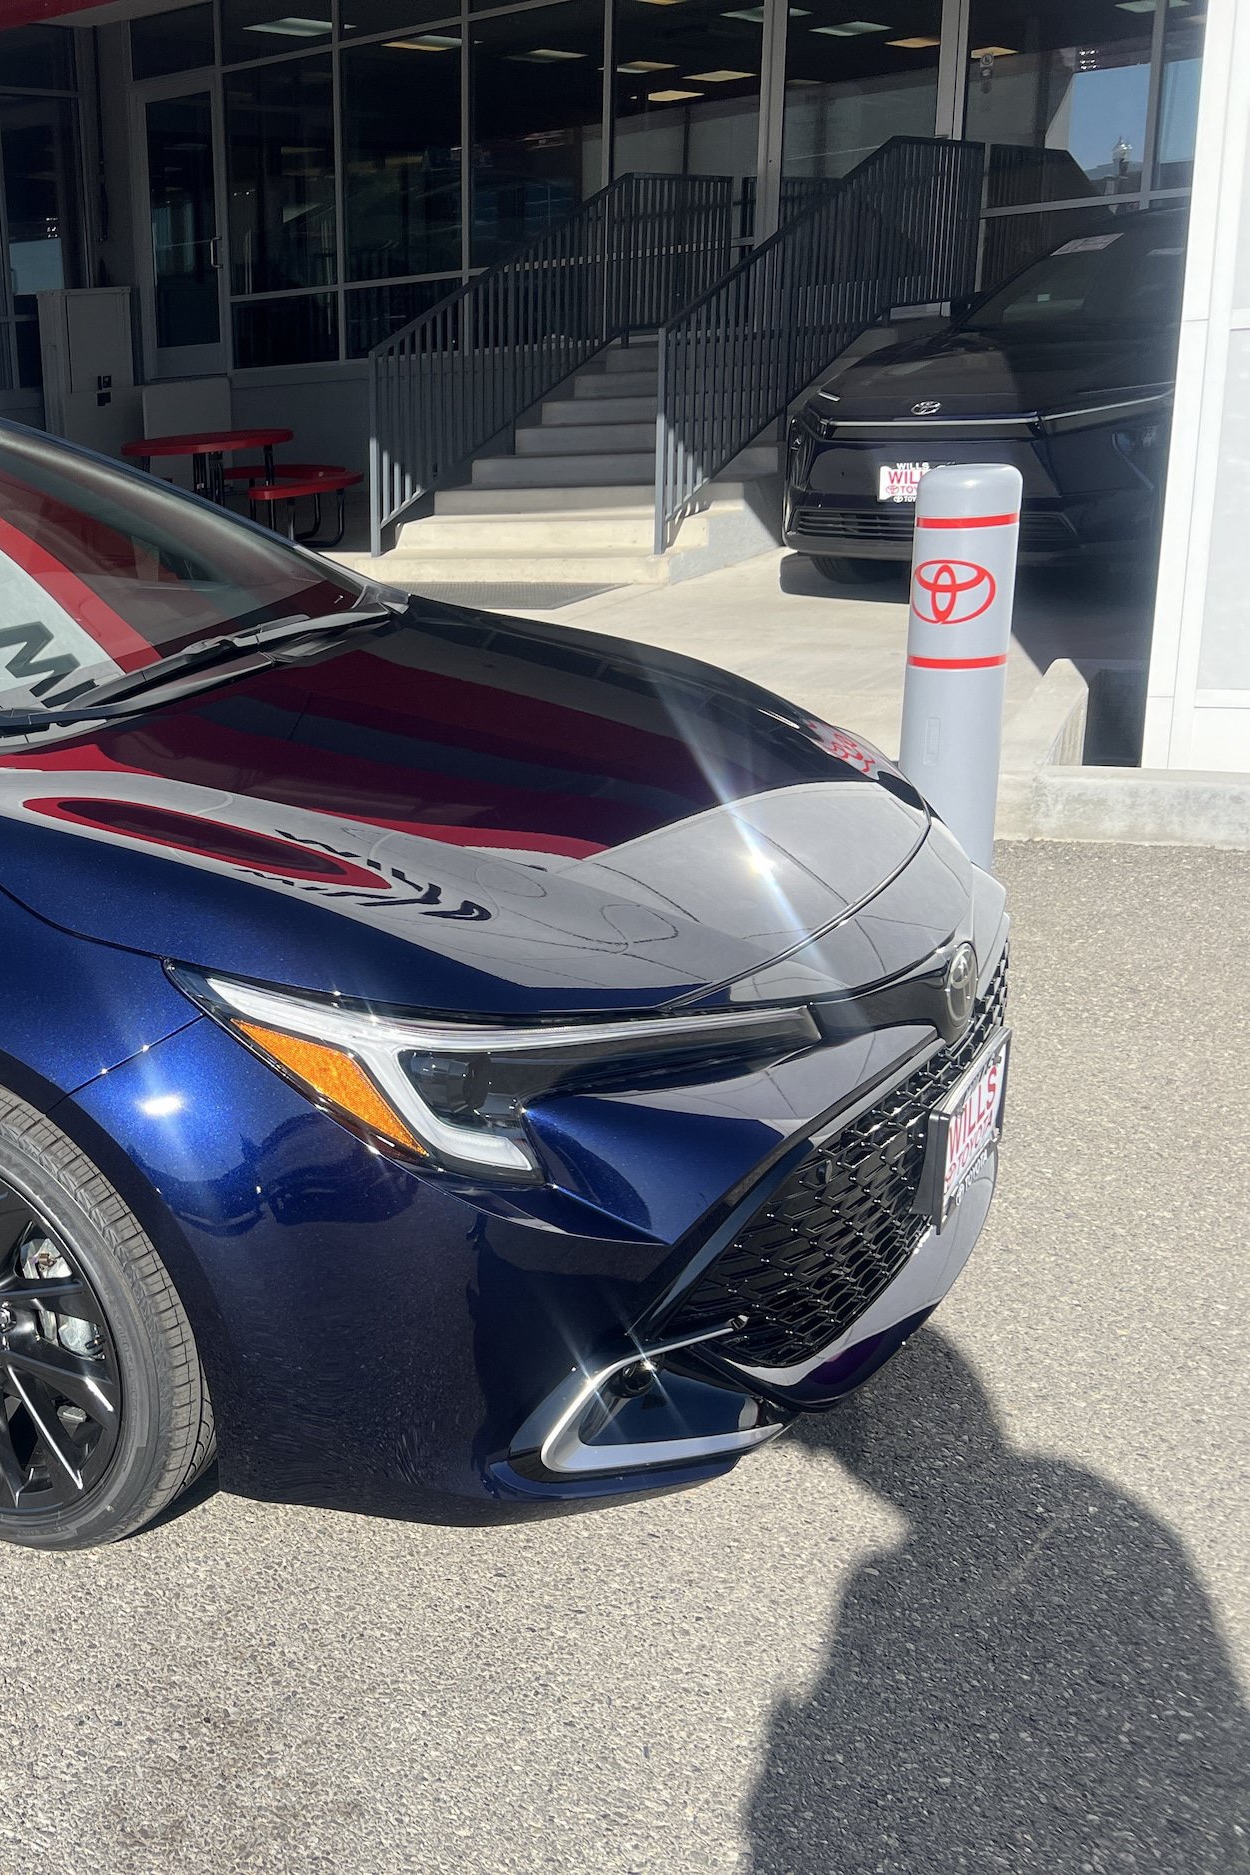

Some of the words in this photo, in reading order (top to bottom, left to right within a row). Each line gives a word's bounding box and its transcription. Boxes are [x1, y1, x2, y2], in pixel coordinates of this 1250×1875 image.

[888, 470, 925, 484] WIL
[896, 462, 930, 470] WILLS
[948, 1065, 997, 1163] WILLS
[957, 1110, 993, 1168] TOYOTA
[965, 1149, 989, 1190] TOYOTA
